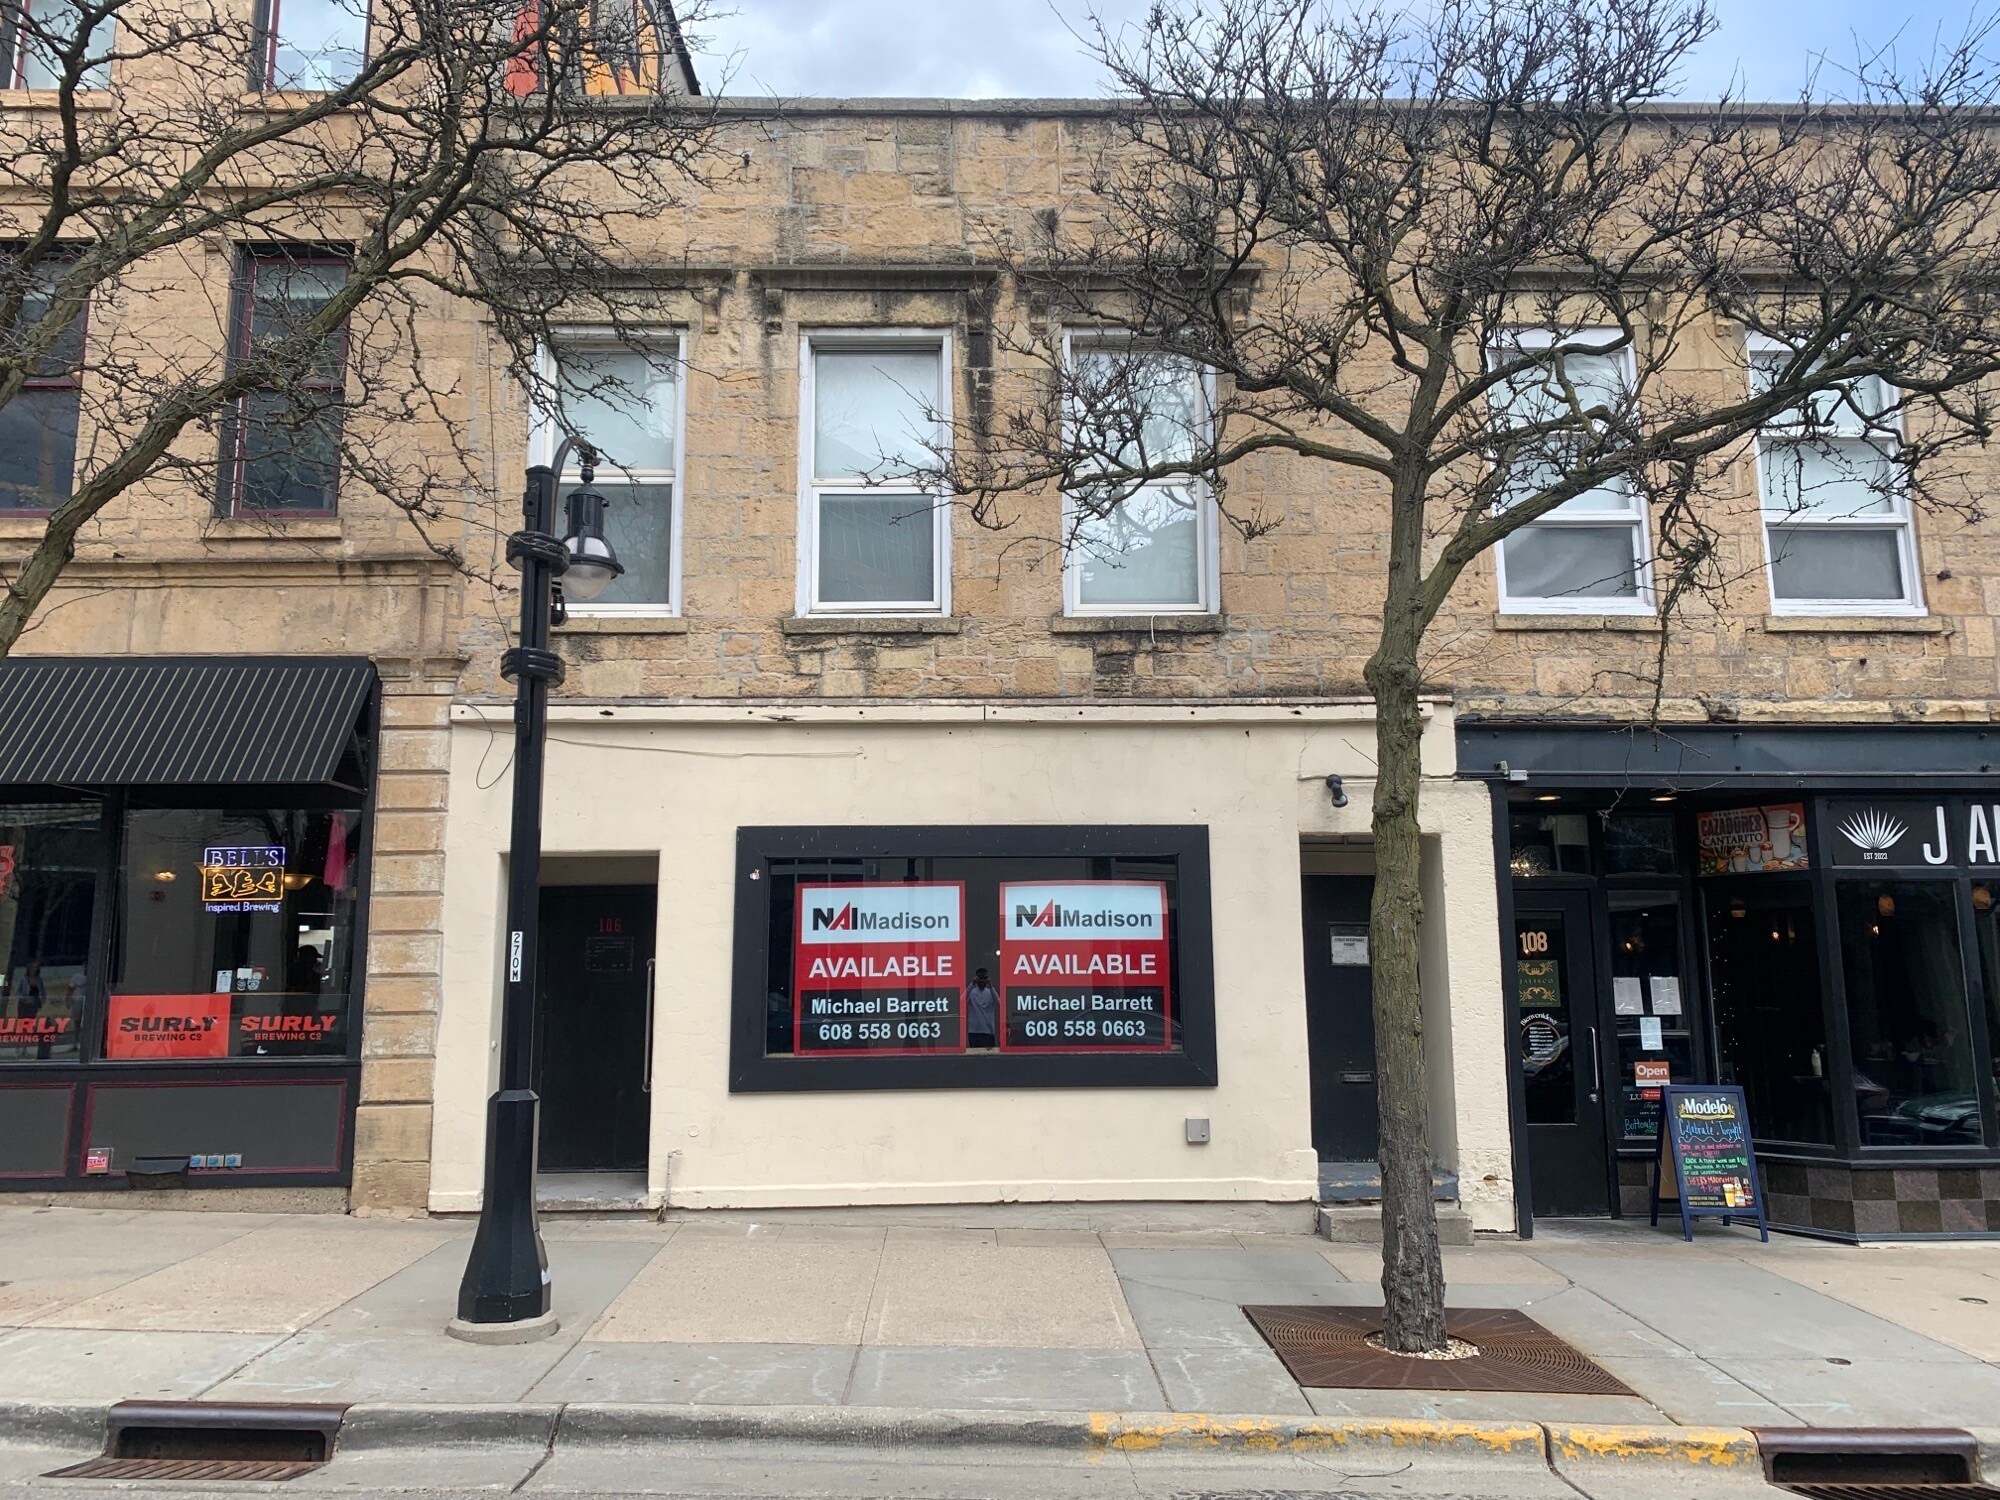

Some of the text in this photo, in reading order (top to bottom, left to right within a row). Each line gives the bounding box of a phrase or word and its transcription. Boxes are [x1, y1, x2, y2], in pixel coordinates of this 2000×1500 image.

[1701, 815, 1762, 837] CAZADORES
[1703, 833, 1763, 847] CANTARITO
[210, 850, 279, 867] BELL'S
[1874, 852, 1888, 860] 2023
[205, 901, 279, 914] Inspired Brewing
[813, 901, 949, 931] NAI Madison
[1016, 899, 1152, 927] NAI Madison
[599, 917, 622, 933] 106
[1520, 931, 1548, 952] 108
[808, 956, 953, 978] AVAILABLE
[1013, 954, 1157, 975] AVAILABLE
[811, 997, 949, 1014] Michael Barrett
[1017, 995, 1153, 1010] Michael Barrett
[0, 1017, 71, 1034] URLY
[120, 1016, 218, 1032] SURLY
[240, 1015, 337, 1032] SURLY
[819, 1022, 941, 1040] 608 558 0663
[1025, 1021, 1146, 1037] 608 558 0663
[0, 1035, 40, 1043] EWING
[134, 1033, 186, 1041] BREWING
[254, 1032, 306, 1041] BREWING
[1636, 1065, 1668, 1078] Open
[1684, 1097, 1728, 1115] Modelo
